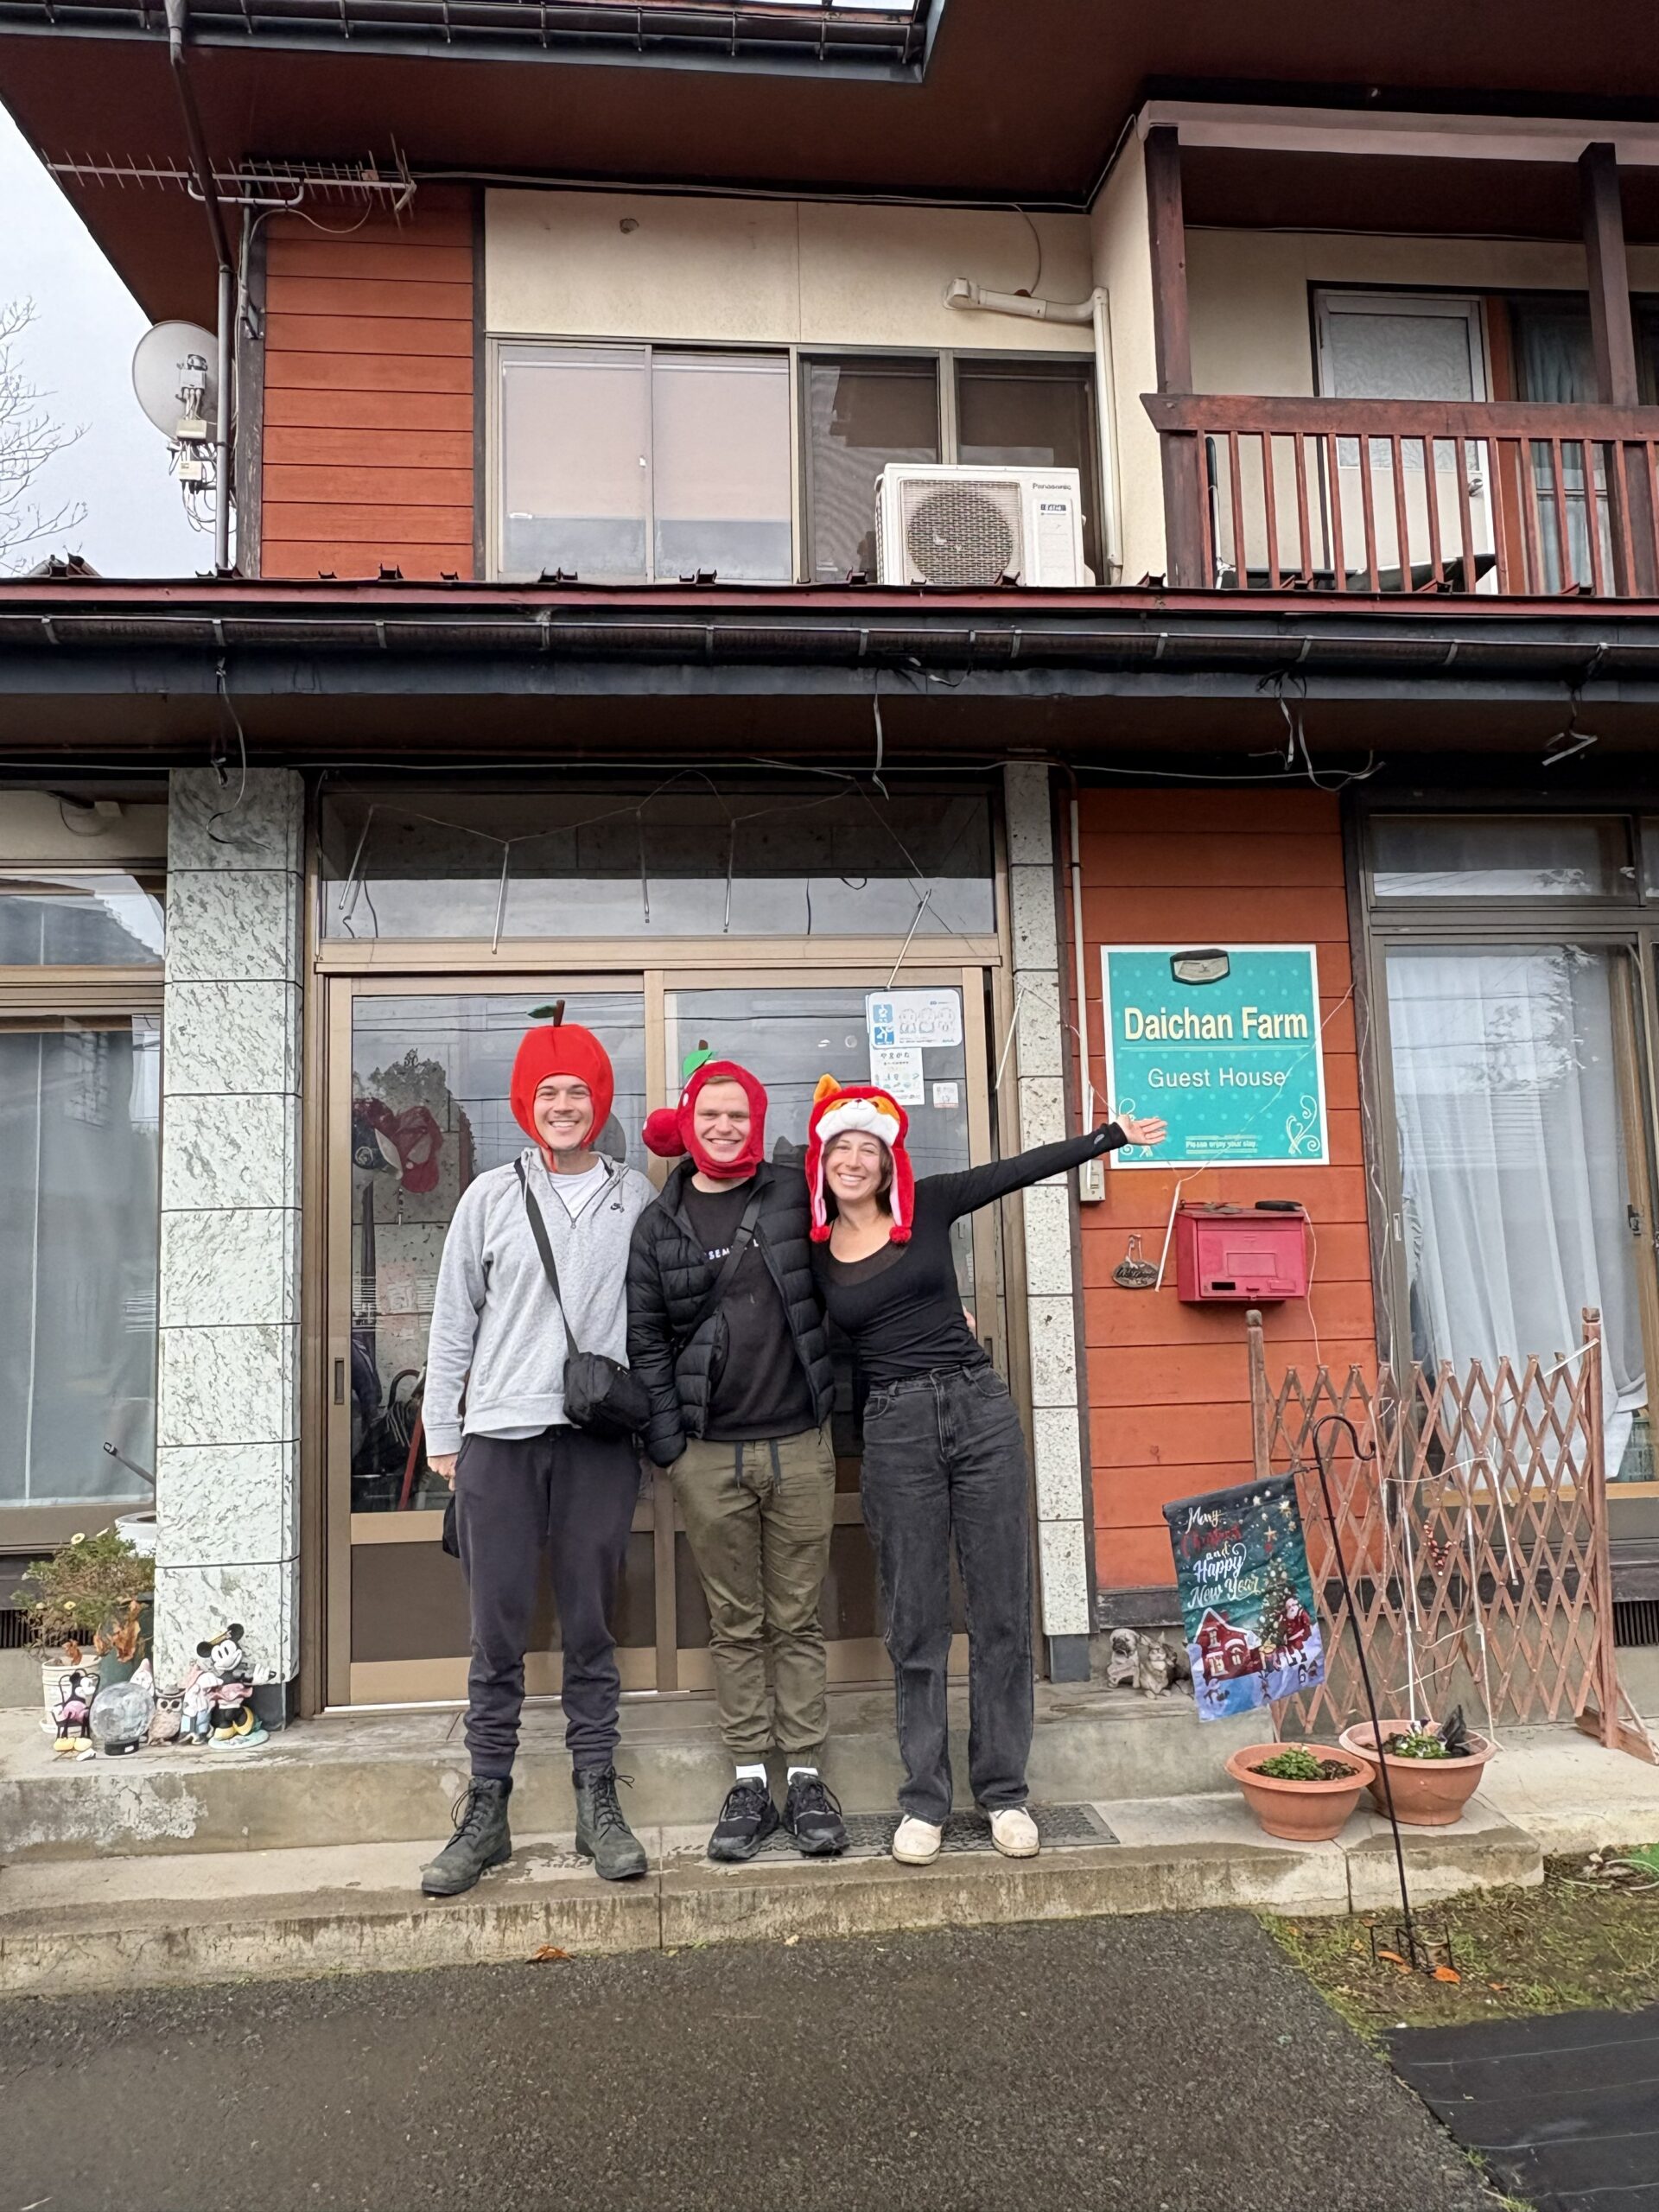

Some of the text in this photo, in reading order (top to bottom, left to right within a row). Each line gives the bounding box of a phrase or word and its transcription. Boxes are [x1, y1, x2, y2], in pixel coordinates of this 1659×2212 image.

[1124, 1007, 1308, 1040] Daichan Farm
[1147, 1068, 1286, 1088] Guest House
[1192, 1542, 1246, 1583] Happy
[1205, 1541, 1230, 1560] and
[1187, 1573, 1262, 1608] New Year
